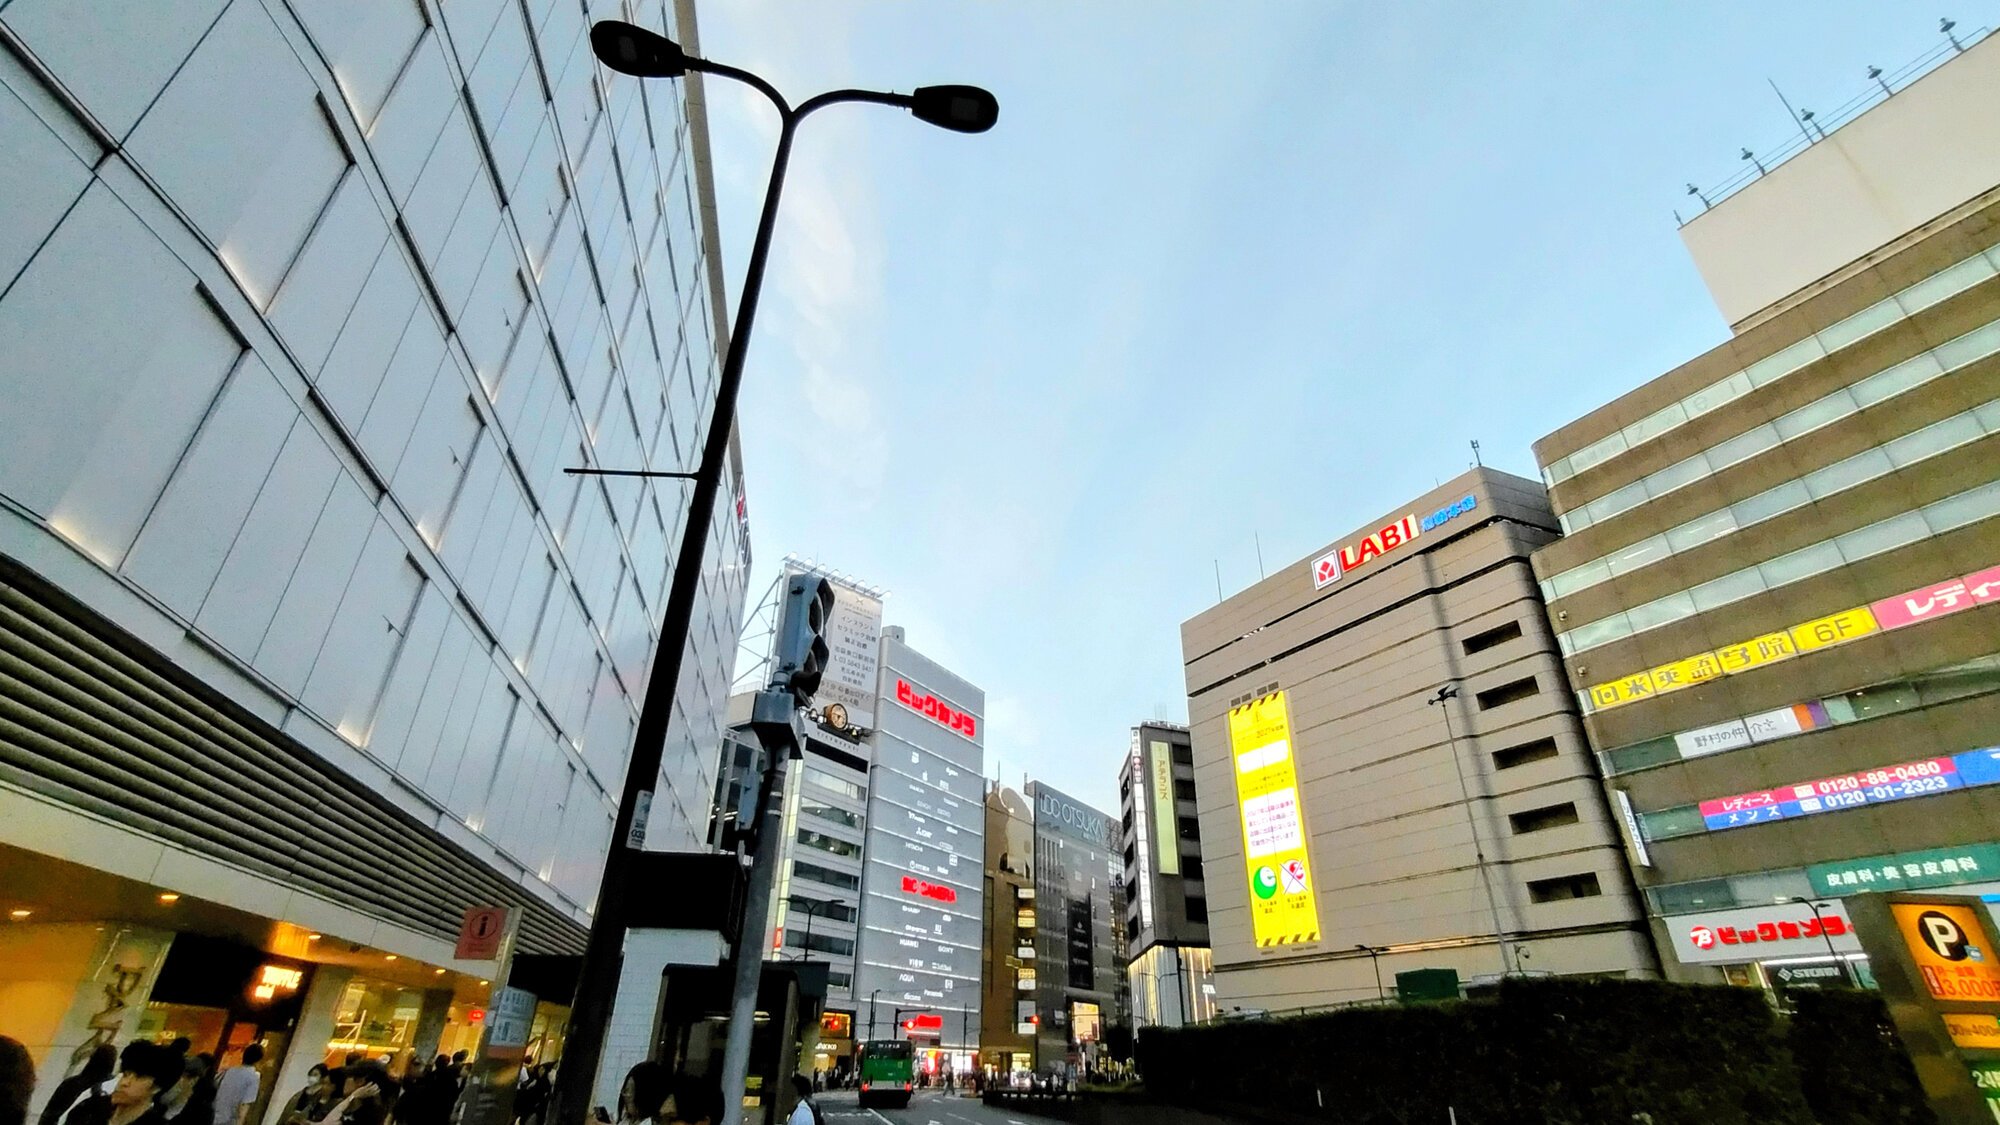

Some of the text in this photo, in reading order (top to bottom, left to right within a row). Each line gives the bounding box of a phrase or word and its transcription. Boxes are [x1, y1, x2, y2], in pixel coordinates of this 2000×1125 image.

[1339, 514, 1417, 572] LABI
[1814, 617, 1852, 642] 6F
[897, 679, 976, 738] ビックカメラ
[1157, 759, 1169, 801] アデランス
[1819, 761, 1941, 794] 0120-88-0480
[1825, 776, 1948, 808] 0120-01-2323
[1722, 793, 1774, 811] レディース
[1728, 806, 1780, 824] メンズ
[1061, 803, 1104, 840] OTSUKA
[1826, 857, 1978, 887] 皮膚科・美容皮膚科
[1717, 916, 1846, 945] ビックカメラ
[1924, 917, 1959, 957] P
[938, 945, 954, 954] SONY
[899, 973, 915, 982] AQUA
